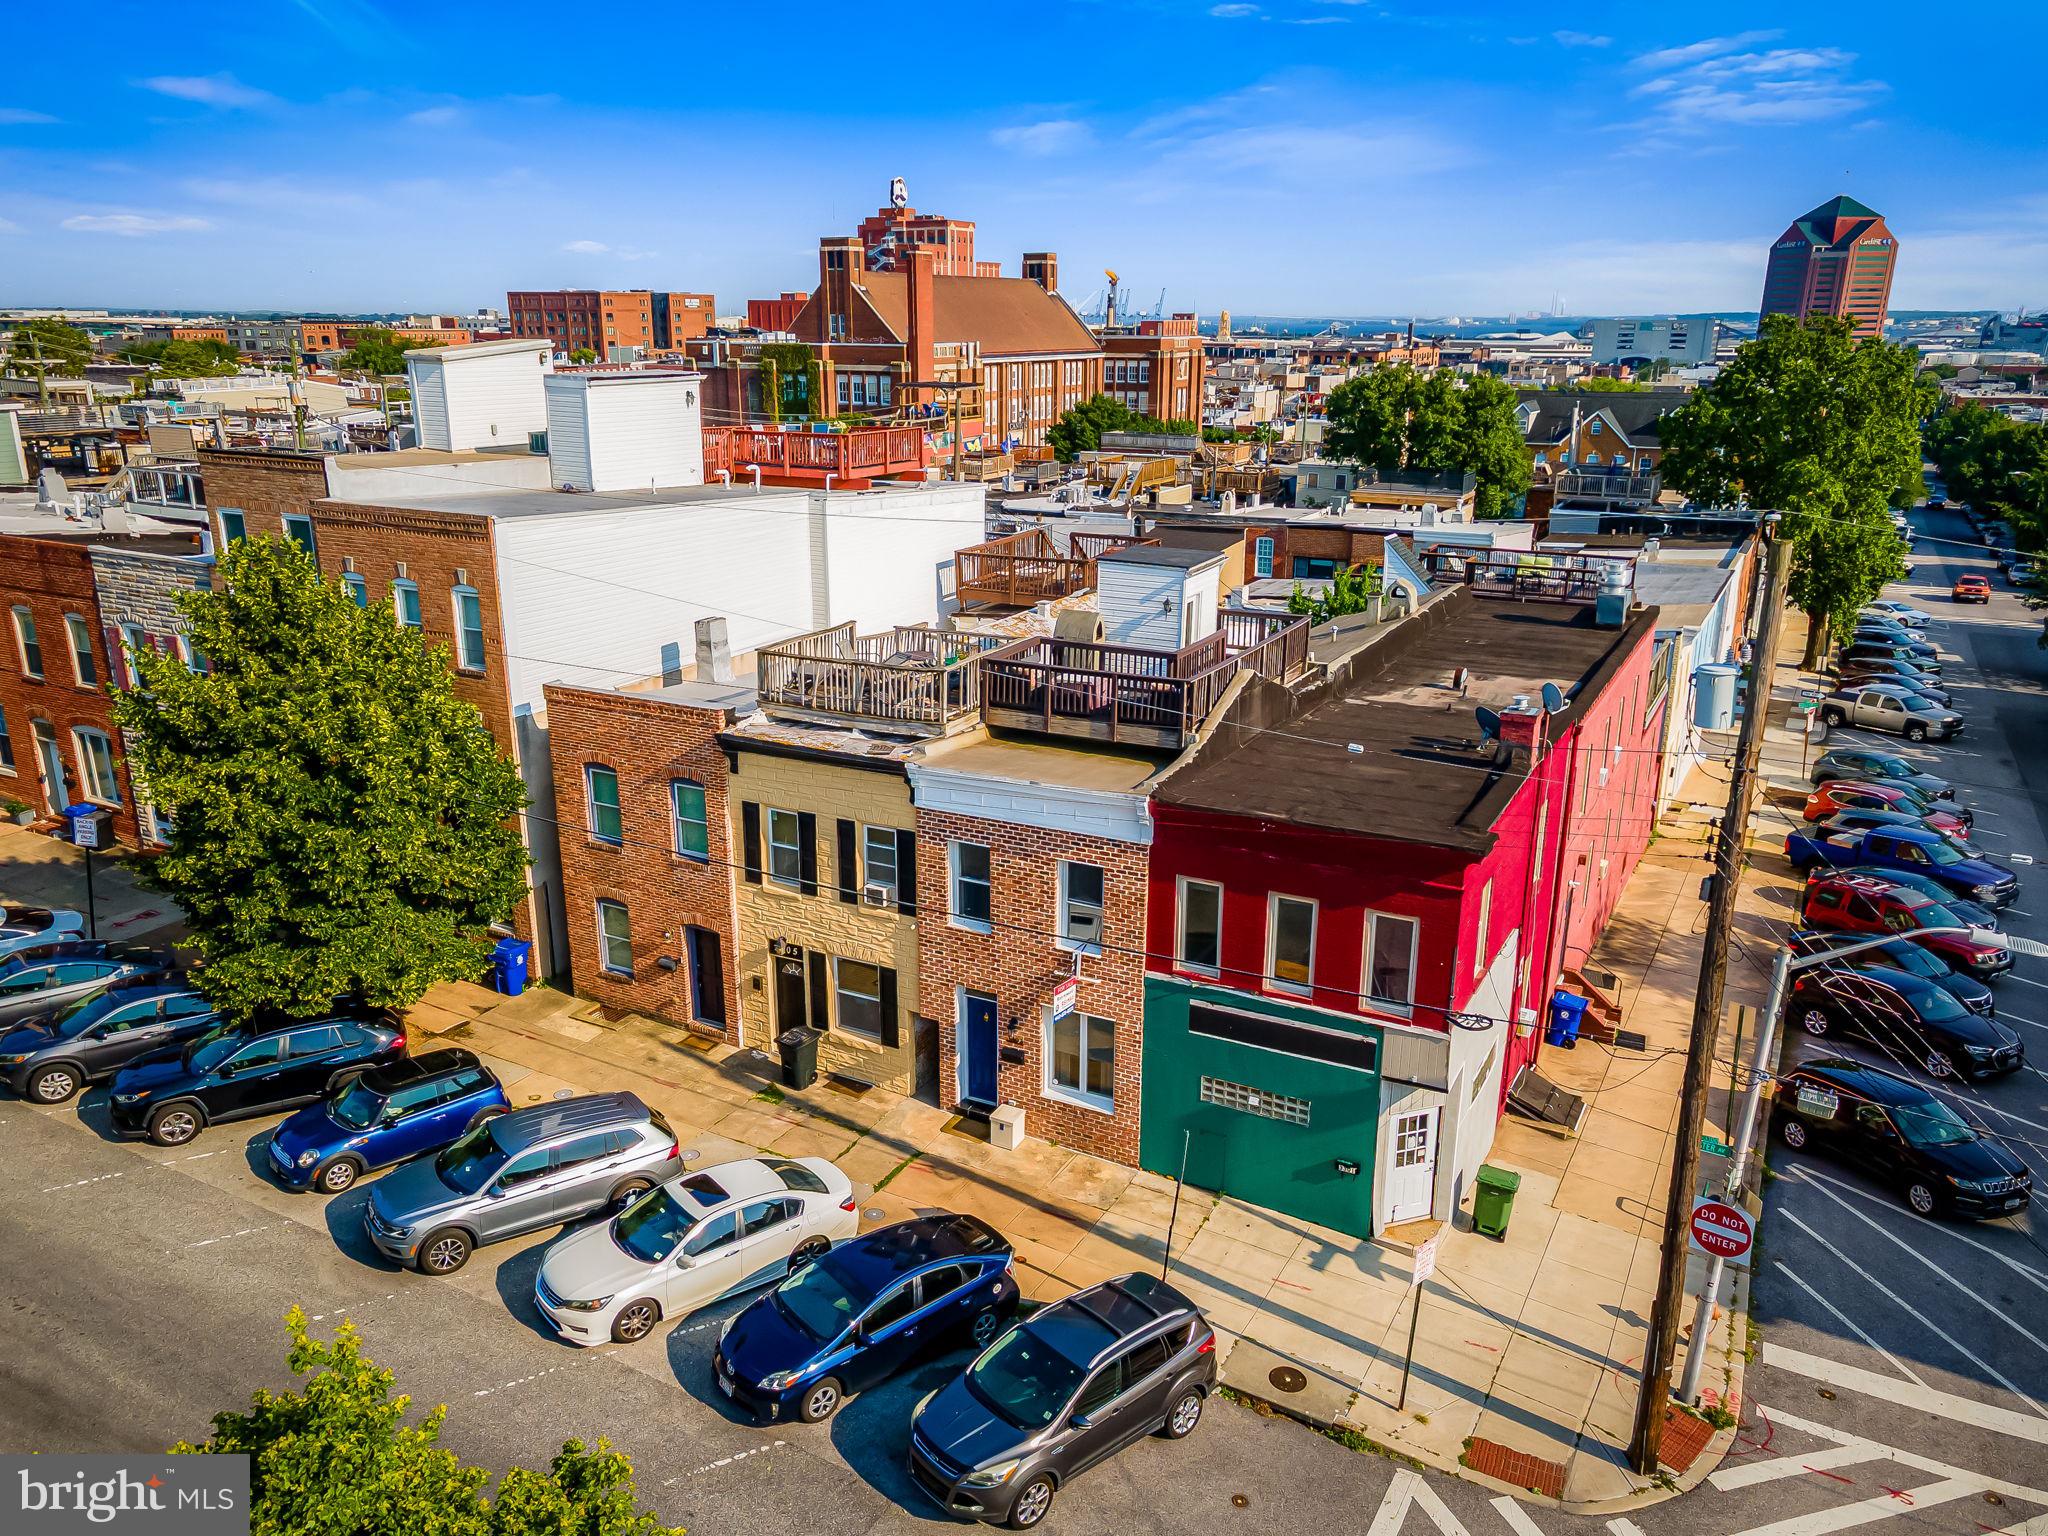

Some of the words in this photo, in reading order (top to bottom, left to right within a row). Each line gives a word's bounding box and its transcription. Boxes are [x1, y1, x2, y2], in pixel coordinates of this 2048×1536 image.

[1701, 1209, 1716, 1221] DO
[1722, 1216, 1745, 1231] NOT
[1701, 1233, 1736, 1251] ENTER
